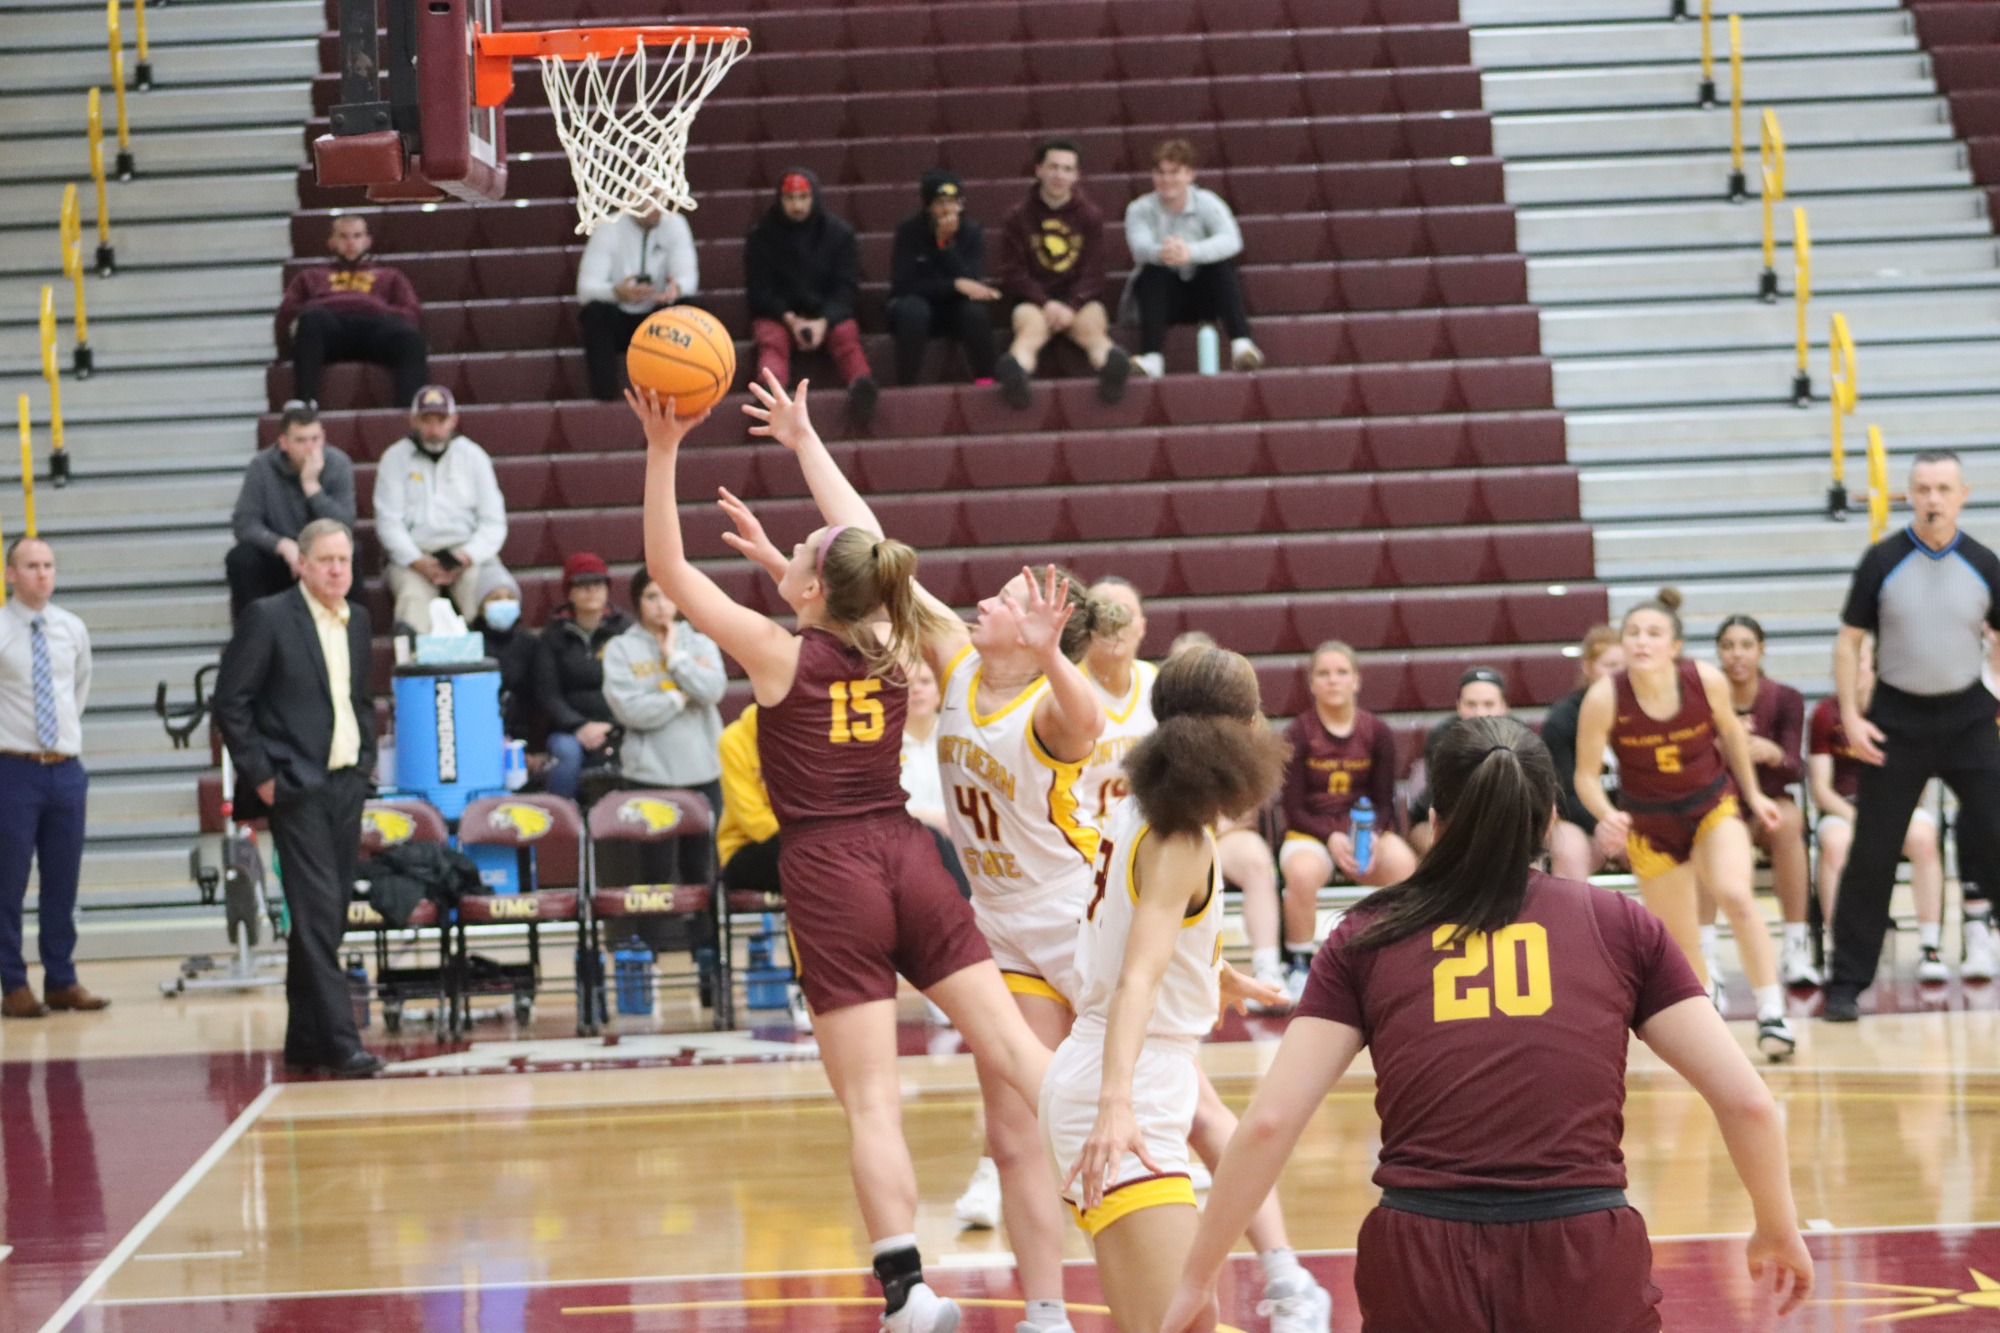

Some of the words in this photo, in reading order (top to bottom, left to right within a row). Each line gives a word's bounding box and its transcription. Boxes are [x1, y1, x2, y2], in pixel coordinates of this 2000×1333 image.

[829, 678, 885, 743] 15
[1655, 745, 1681, 773] 5
[953, 784, 1001, 842] 41
[489, 898, 540, 918] UMC
[624, 891, 675, 912] UMC
[1432, 921, 1553, 1022] 20
